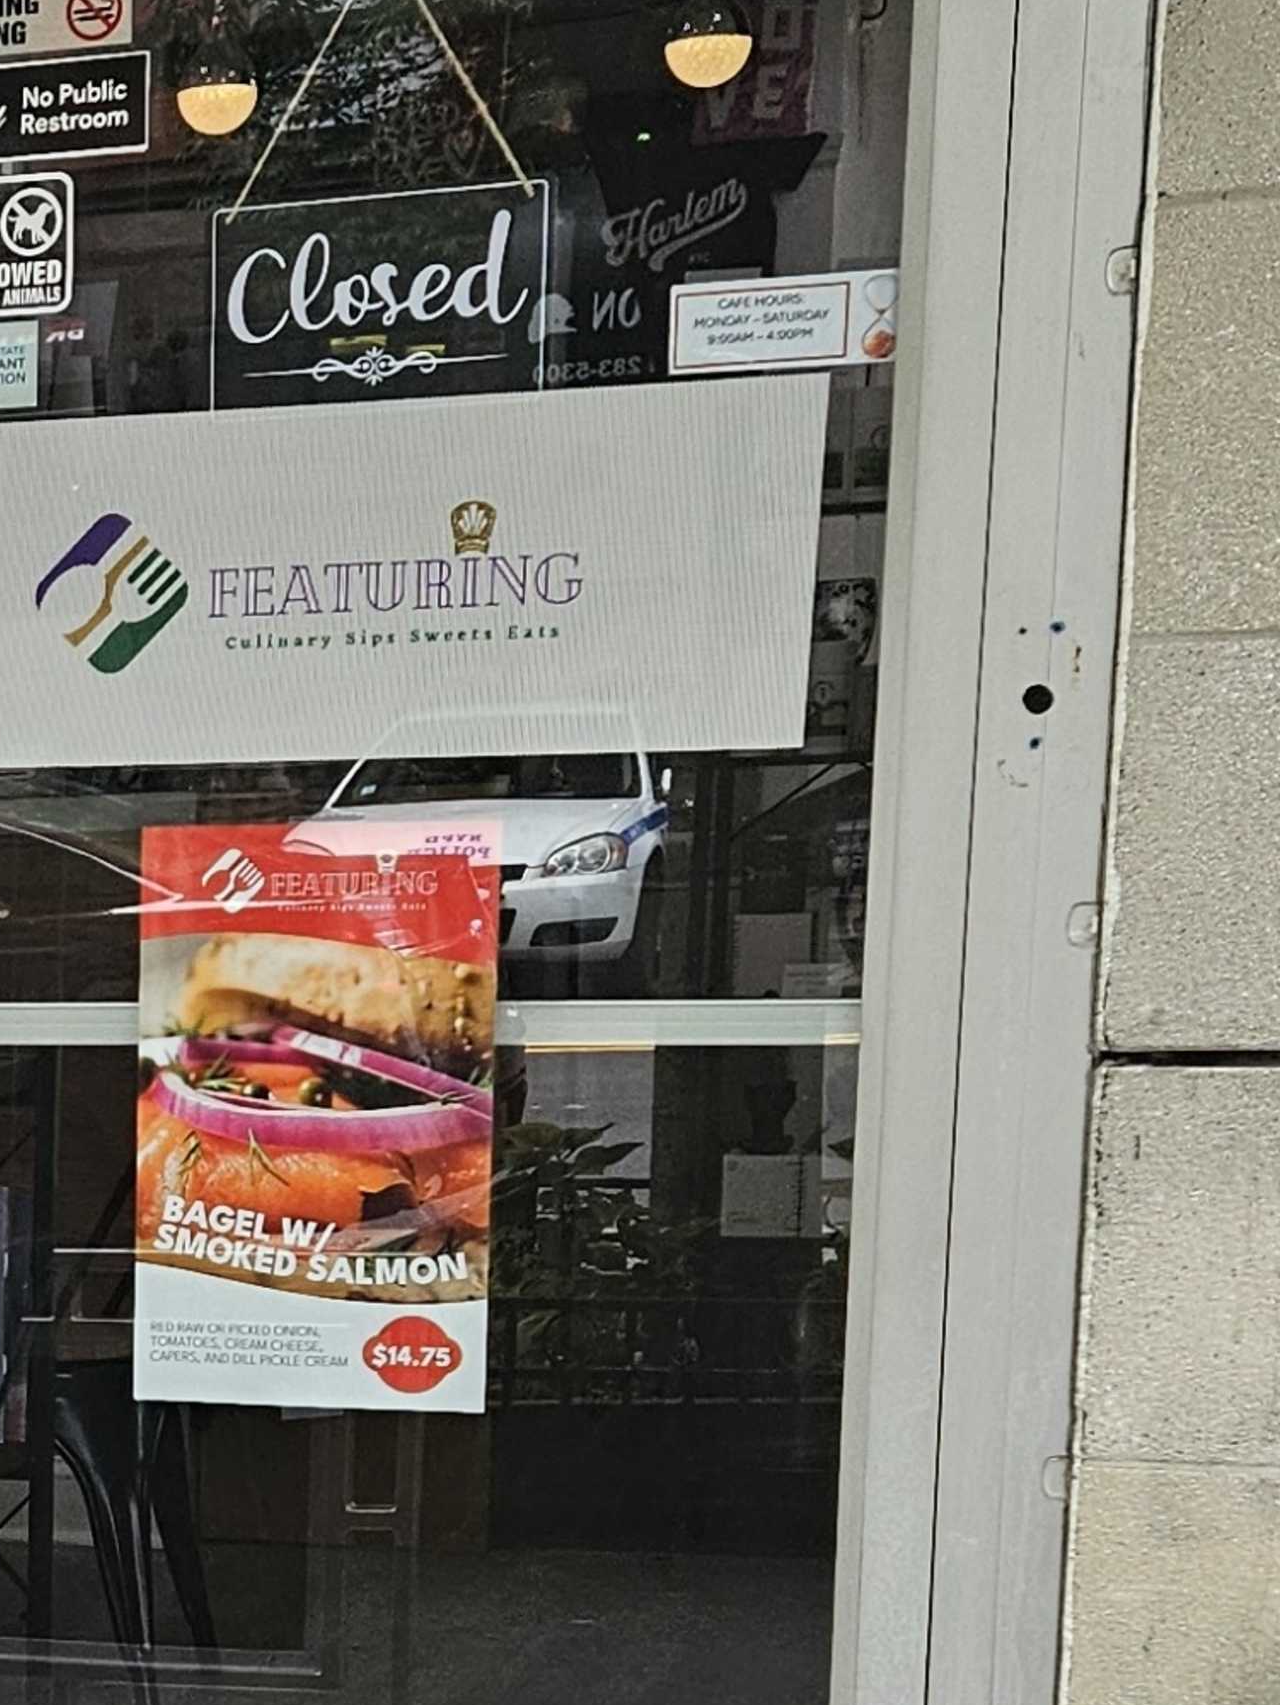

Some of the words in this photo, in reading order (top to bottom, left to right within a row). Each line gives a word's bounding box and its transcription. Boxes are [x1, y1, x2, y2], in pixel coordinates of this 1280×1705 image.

[22, 85, 54, 110] No
[58, 78, 129, 106] Public
[20, 108, 130, 136] Restroom
[601, 177, 747, 272] Harlem
[226, 209, 529, 345] Closed
[2, 285, 63, 307] ANIMALS
[717, 296, 750, 310] CAFE
[692, 315, 752, 329] MONDAY
[762, 308, 831, 325] SATURDAY
[206, 551, 584, 620] FEATURING
[225, 631, 333, 651] Culinary
[345, 630, 398, 646] Sips
[409, 627, 494, 643] Sweets
[507, 623, 561, 641] Eats
[270, 870, 439, 897] FEATURING
[161, 1195, 273, 1242] BAGEL
[281, 1216, 337, 1253] W/
[152, 1224, 299, 1278] SMOKED
[305, 1251, 469, 1286] SALMON
[149, 1321, 175, 1334] RED
[177, 1323, 205, 1335] RAW
[207, 1323, 226, 1335] OR
[224, 1338, 268, 1351] CREAM
[371, 1343, 452, 1369] $14.75
[204, 1353, 232, 1365] AND
[233, 1354, 258, 1366] DILL
[259, 1355, 302, 1368] PICKLE
[303, 1356, 349, 1368] CREAM
